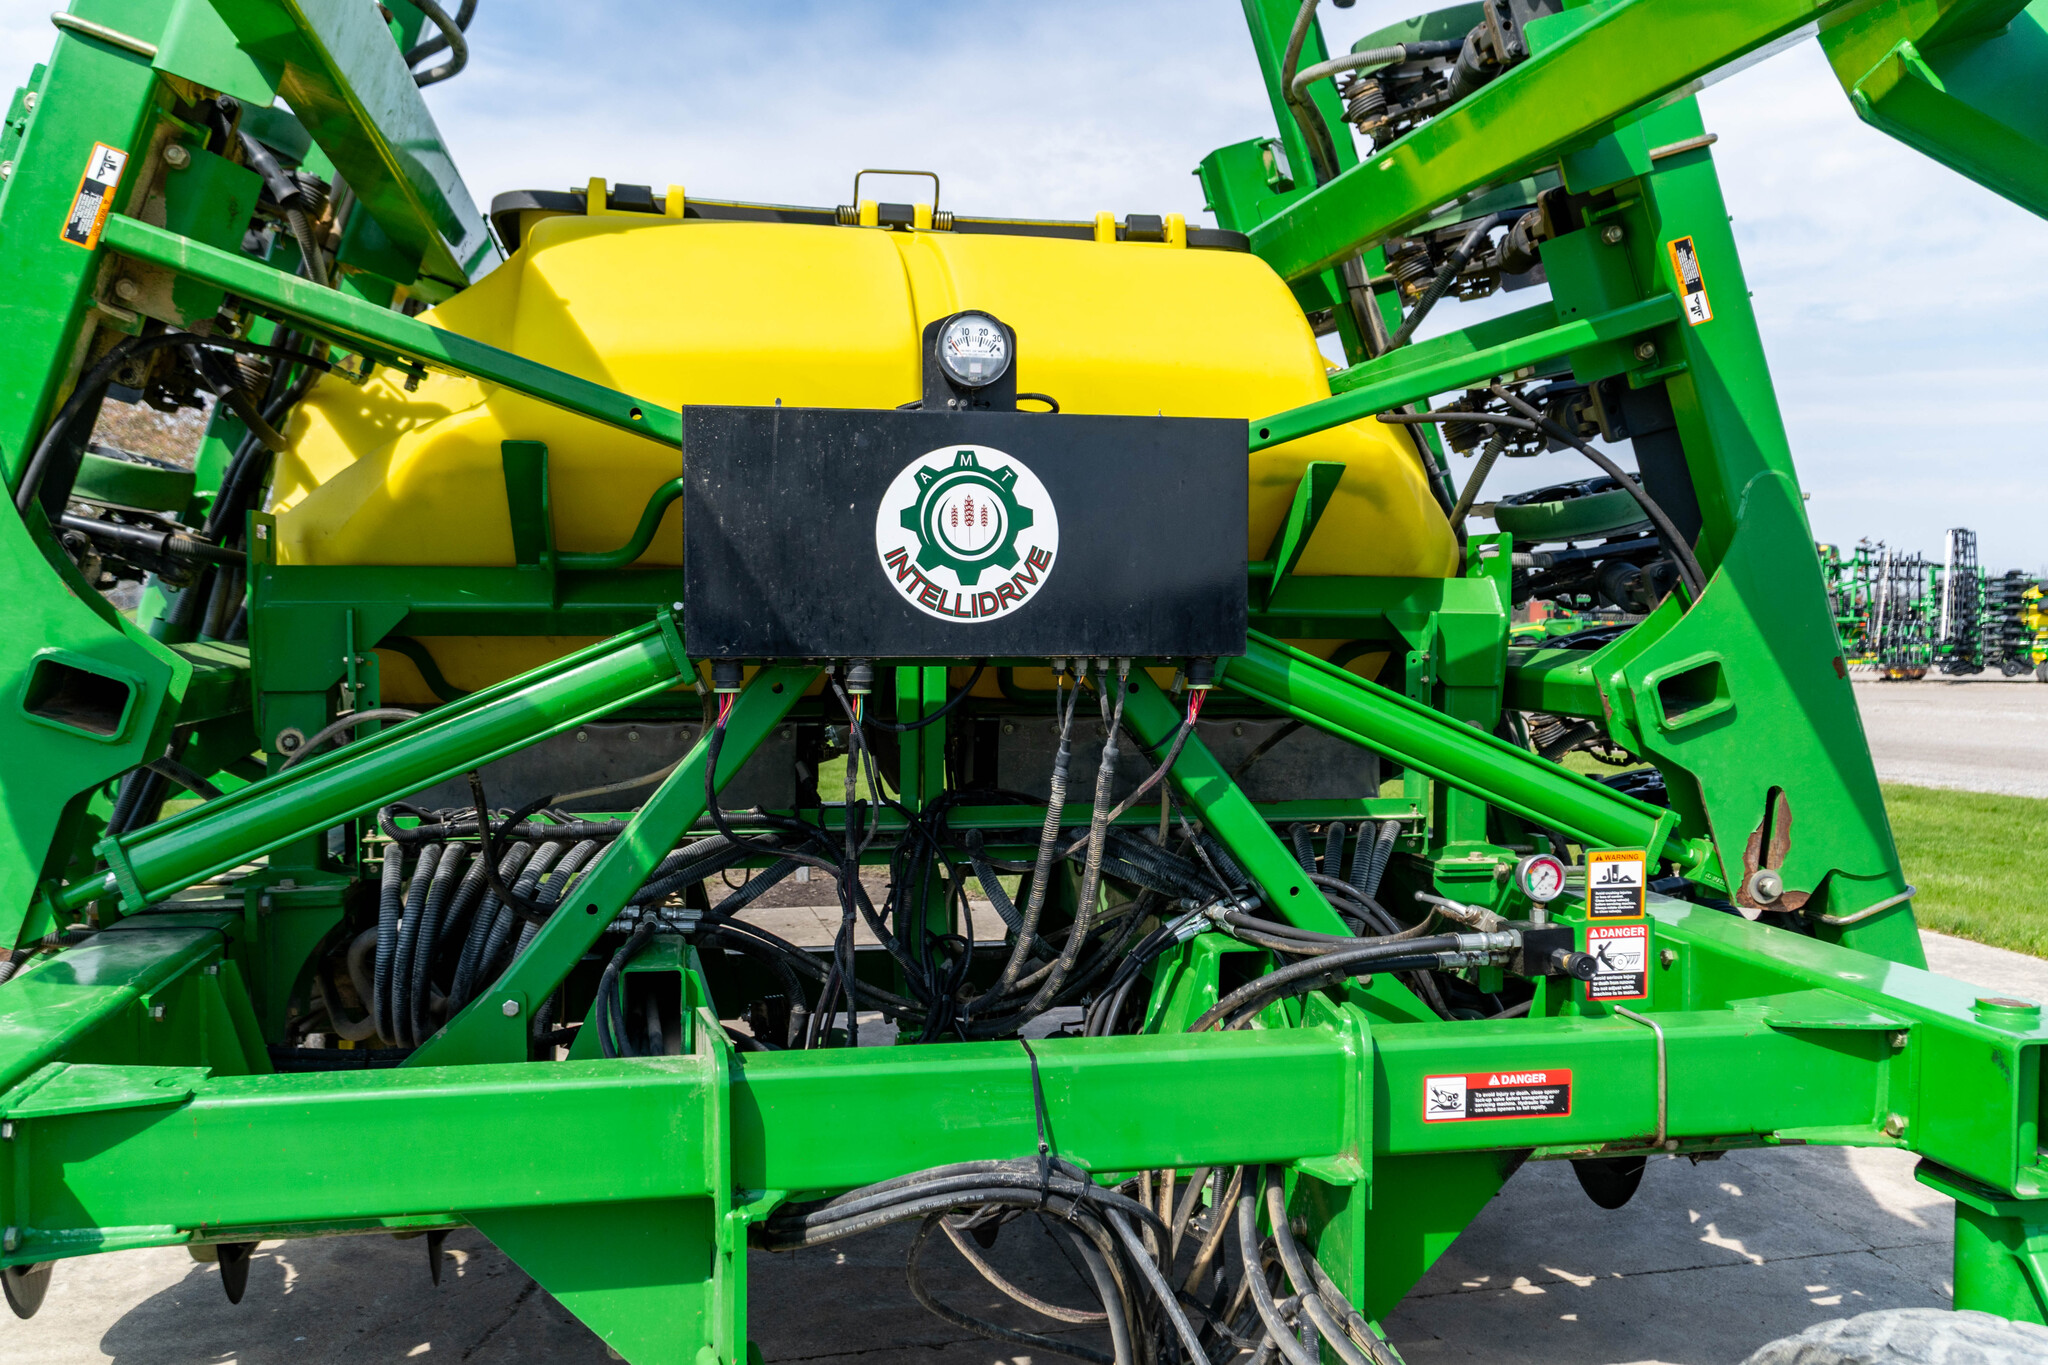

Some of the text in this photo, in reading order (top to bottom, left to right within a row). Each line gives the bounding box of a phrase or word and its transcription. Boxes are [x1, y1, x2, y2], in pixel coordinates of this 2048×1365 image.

[962, 327, 989, 336] 10 20
[992, 334, 1002, 342] 30
[884, 545, 1053, 618] INTELLIDRIVE
[1600, 926, 1645, 938] DANGER
[1501, 1073, 1546, 1084] DANGER
